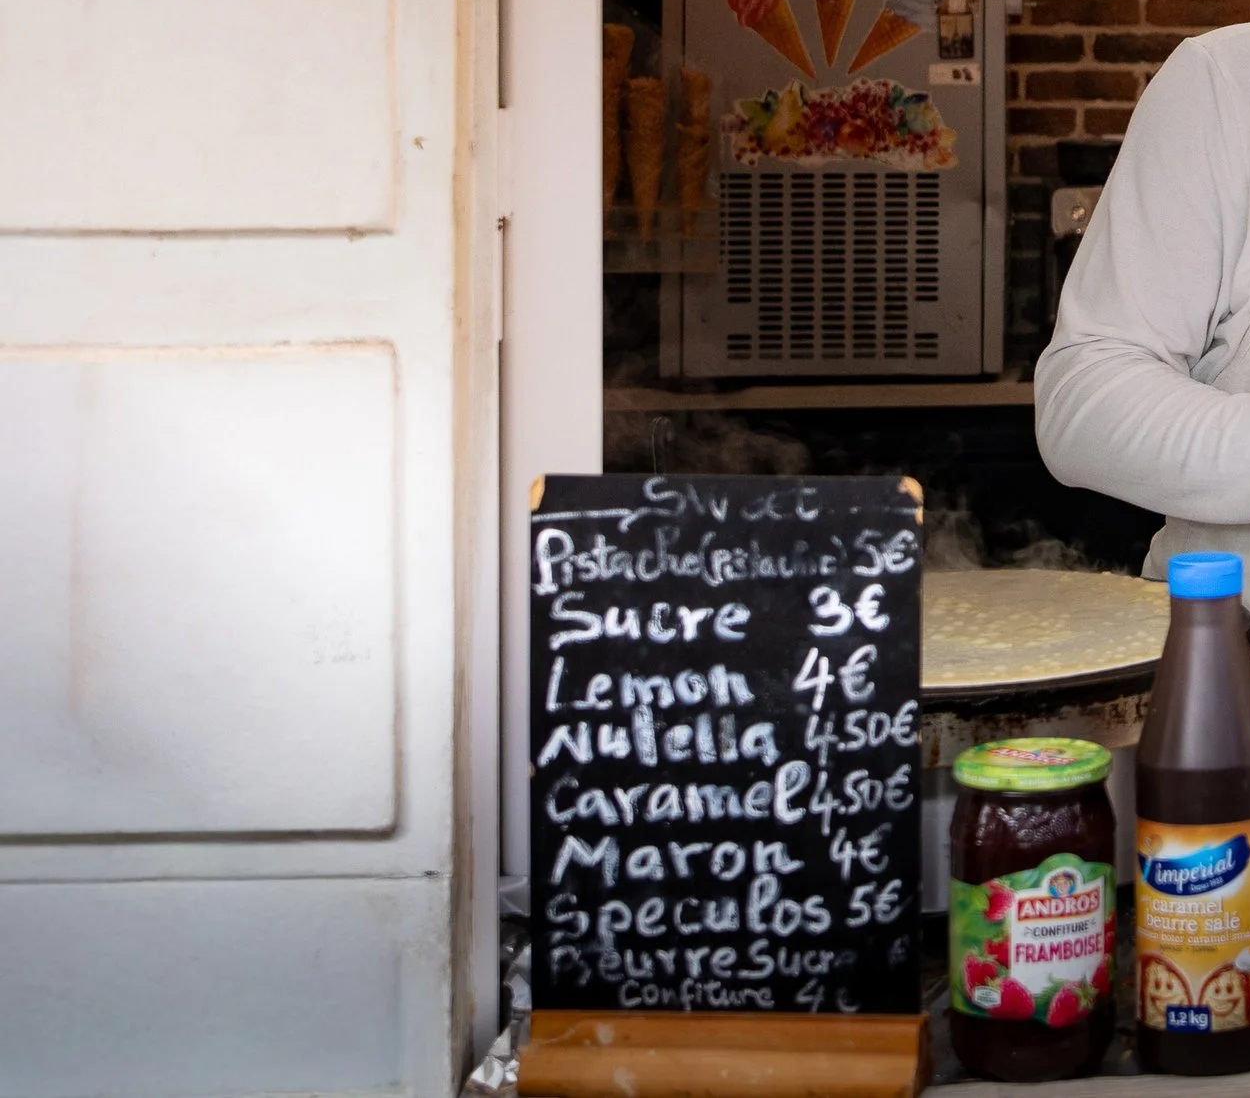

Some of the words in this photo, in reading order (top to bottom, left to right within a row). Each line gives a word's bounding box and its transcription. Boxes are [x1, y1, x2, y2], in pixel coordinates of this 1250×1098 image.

[853, 529, 917, 577] 5€
[549, 591, 751, 650] Sucre
[807, 583, 890, 636] 3€
[545, 656, 755, 713] Lemon
[791, 644, 878, 711] 4€
[804, 700, 918, 767] 4.50€
[545, 760, 811, 825] Caramel
[808, 763, 914, 835] 4.50€
[549, 835, 805, 887] Maron
[830, 823, 892, 879] 4€
[1155, 848, 1236, 893] imperial
[545, 873, 832, 949] Speculos
[845, 879, 903, 927] 5€
[1018, 890, 1100, 921] ANDROS
[1033, 920, 1090, 937] CONFITURE
[1145, 910, 1198, 932] beurre
[1204, 911, 1241, 932] salé
[1152, 897, 1223, 915] caramel
[1015, 933, 1103, 963] FRAMBOISE
[618, 978, 776, 1012] Confiture
